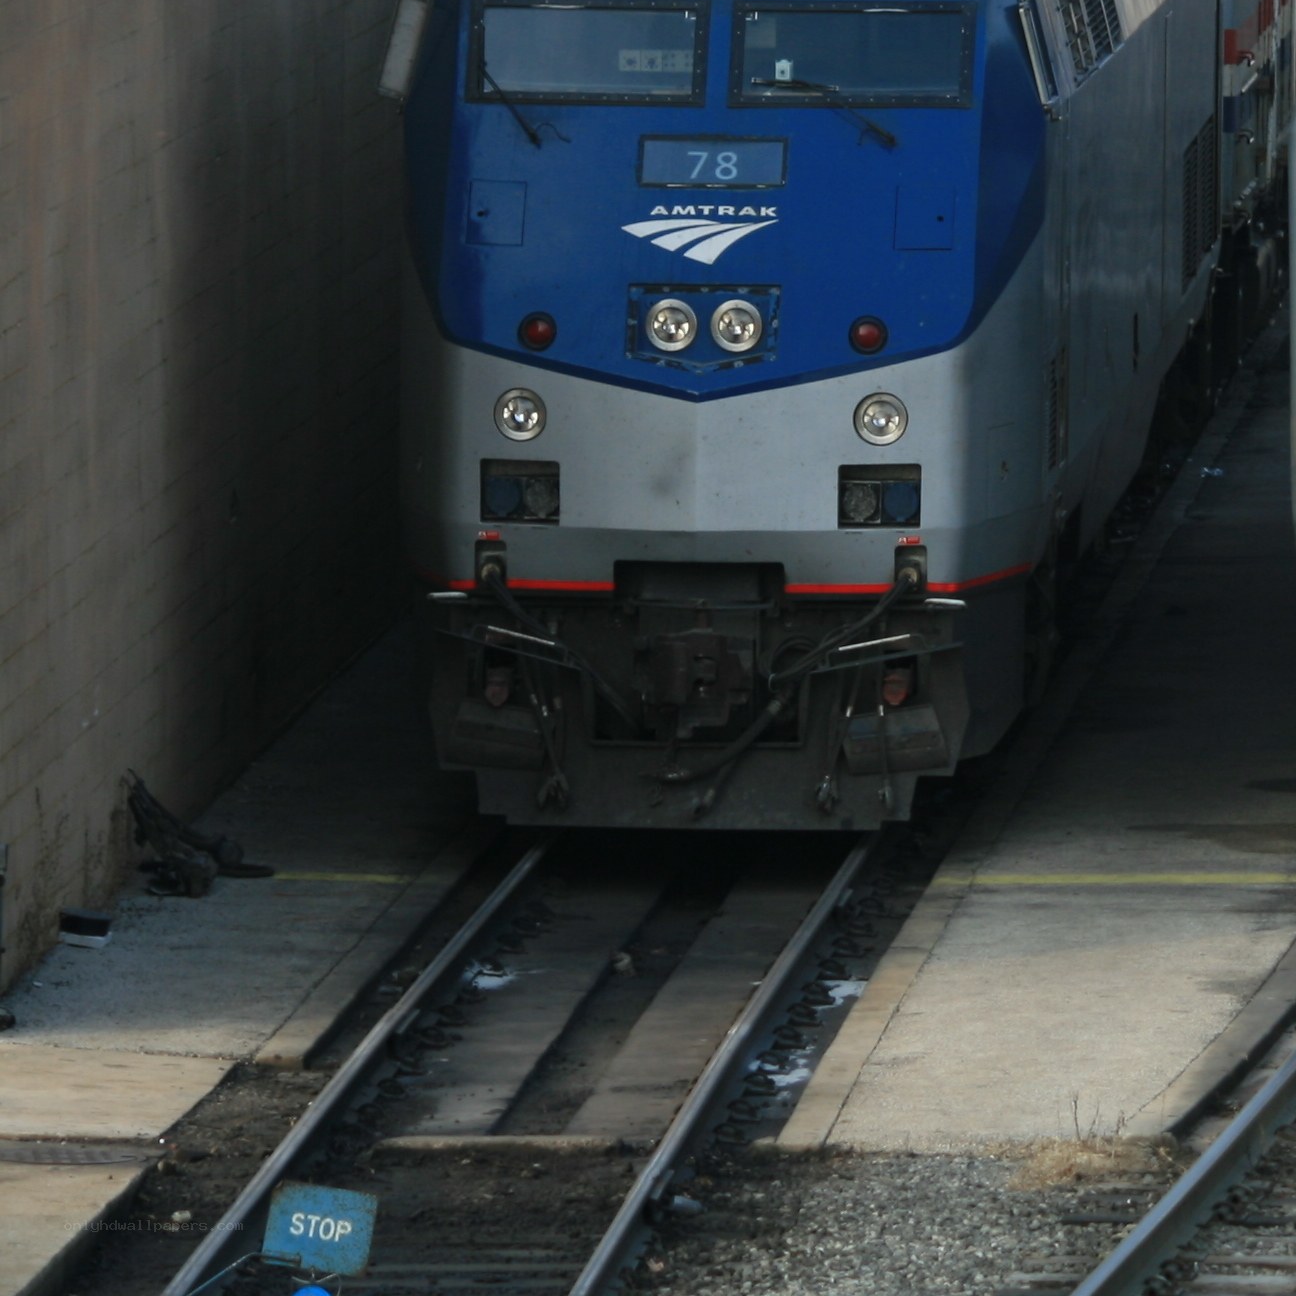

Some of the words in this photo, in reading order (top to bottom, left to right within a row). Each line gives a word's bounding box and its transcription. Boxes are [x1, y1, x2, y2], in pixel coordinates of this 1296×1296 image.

[687, 151, 738, 180] 78
[650, 205, 778, 217] AMTRAK
[289, 1212, 353, 1243] STOP
